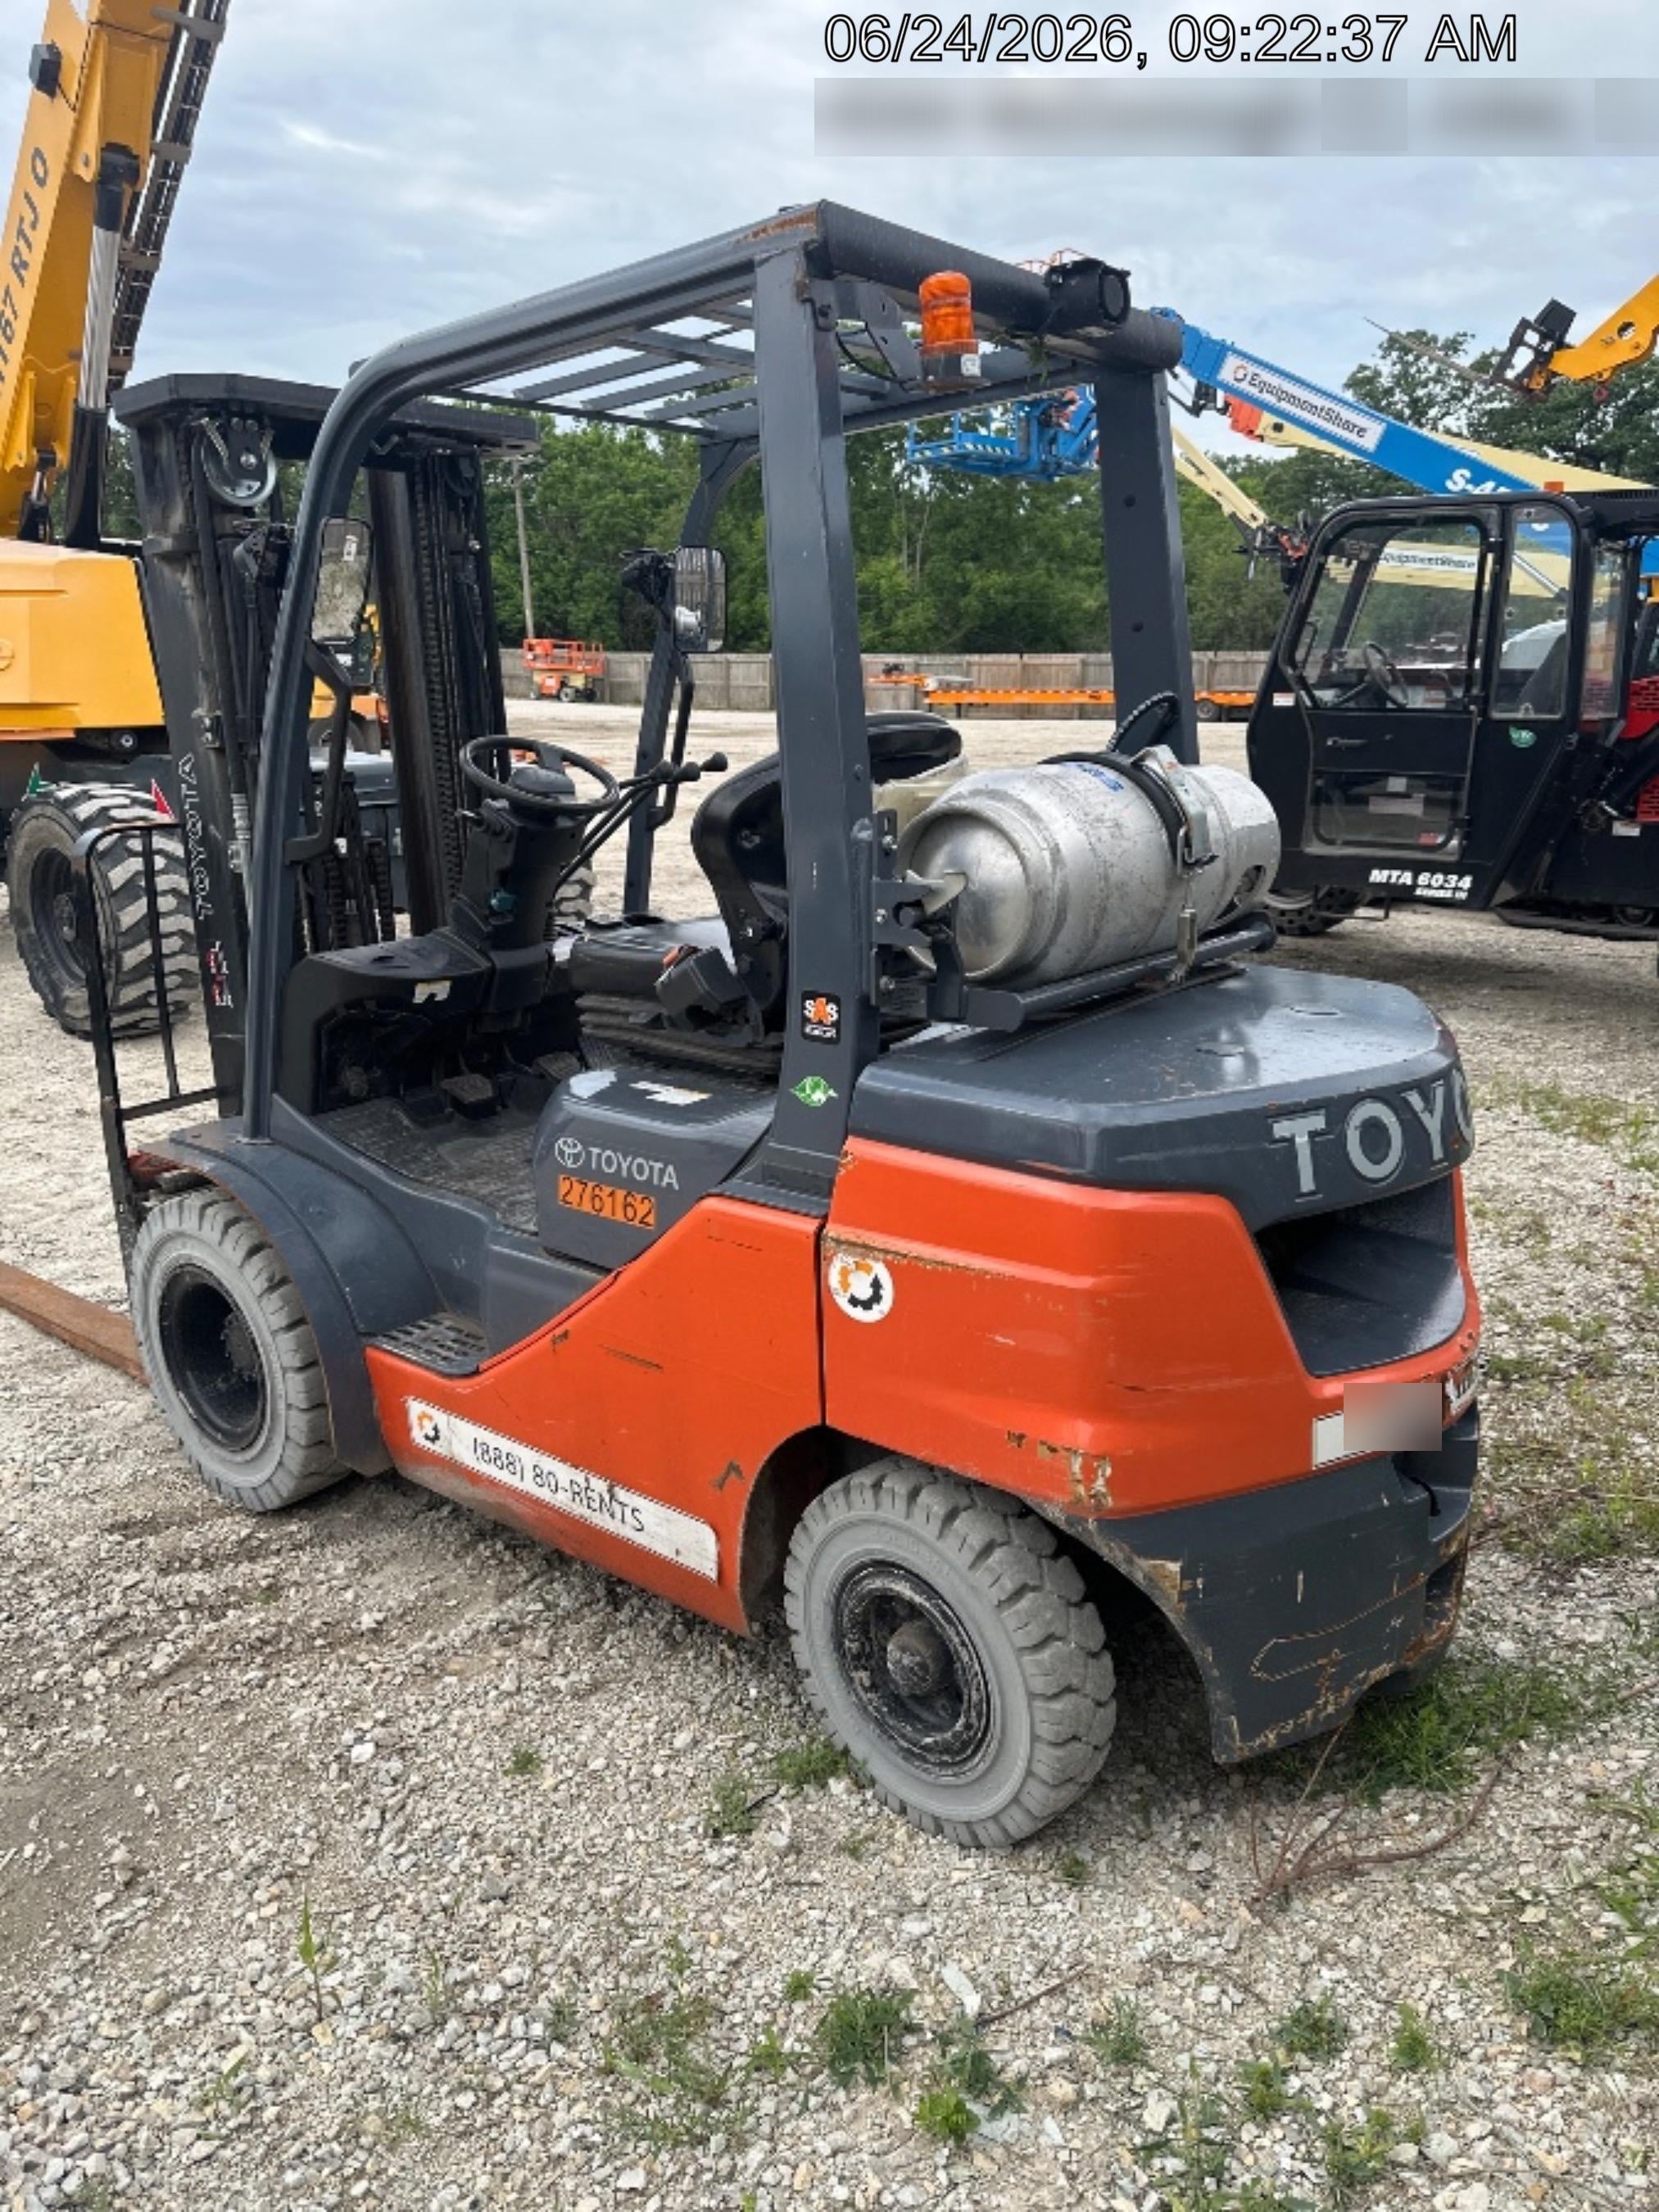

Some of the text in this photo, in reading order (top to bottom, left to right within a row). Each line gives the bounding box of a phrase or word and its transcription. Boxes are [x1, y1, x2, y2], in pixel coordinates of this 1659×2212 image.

[1249, 373, 1368, 438] EquipmentShare
[179, 752, 215, 921] TOYOTA
[1369, 868, 1473, 891] MTA 6034
[587, 1147, 679, 1190] TOYOTA
[561, 1176, 655, 1226] 276162
[473, 1437, 645, 1532] (888) 80-RENTS
